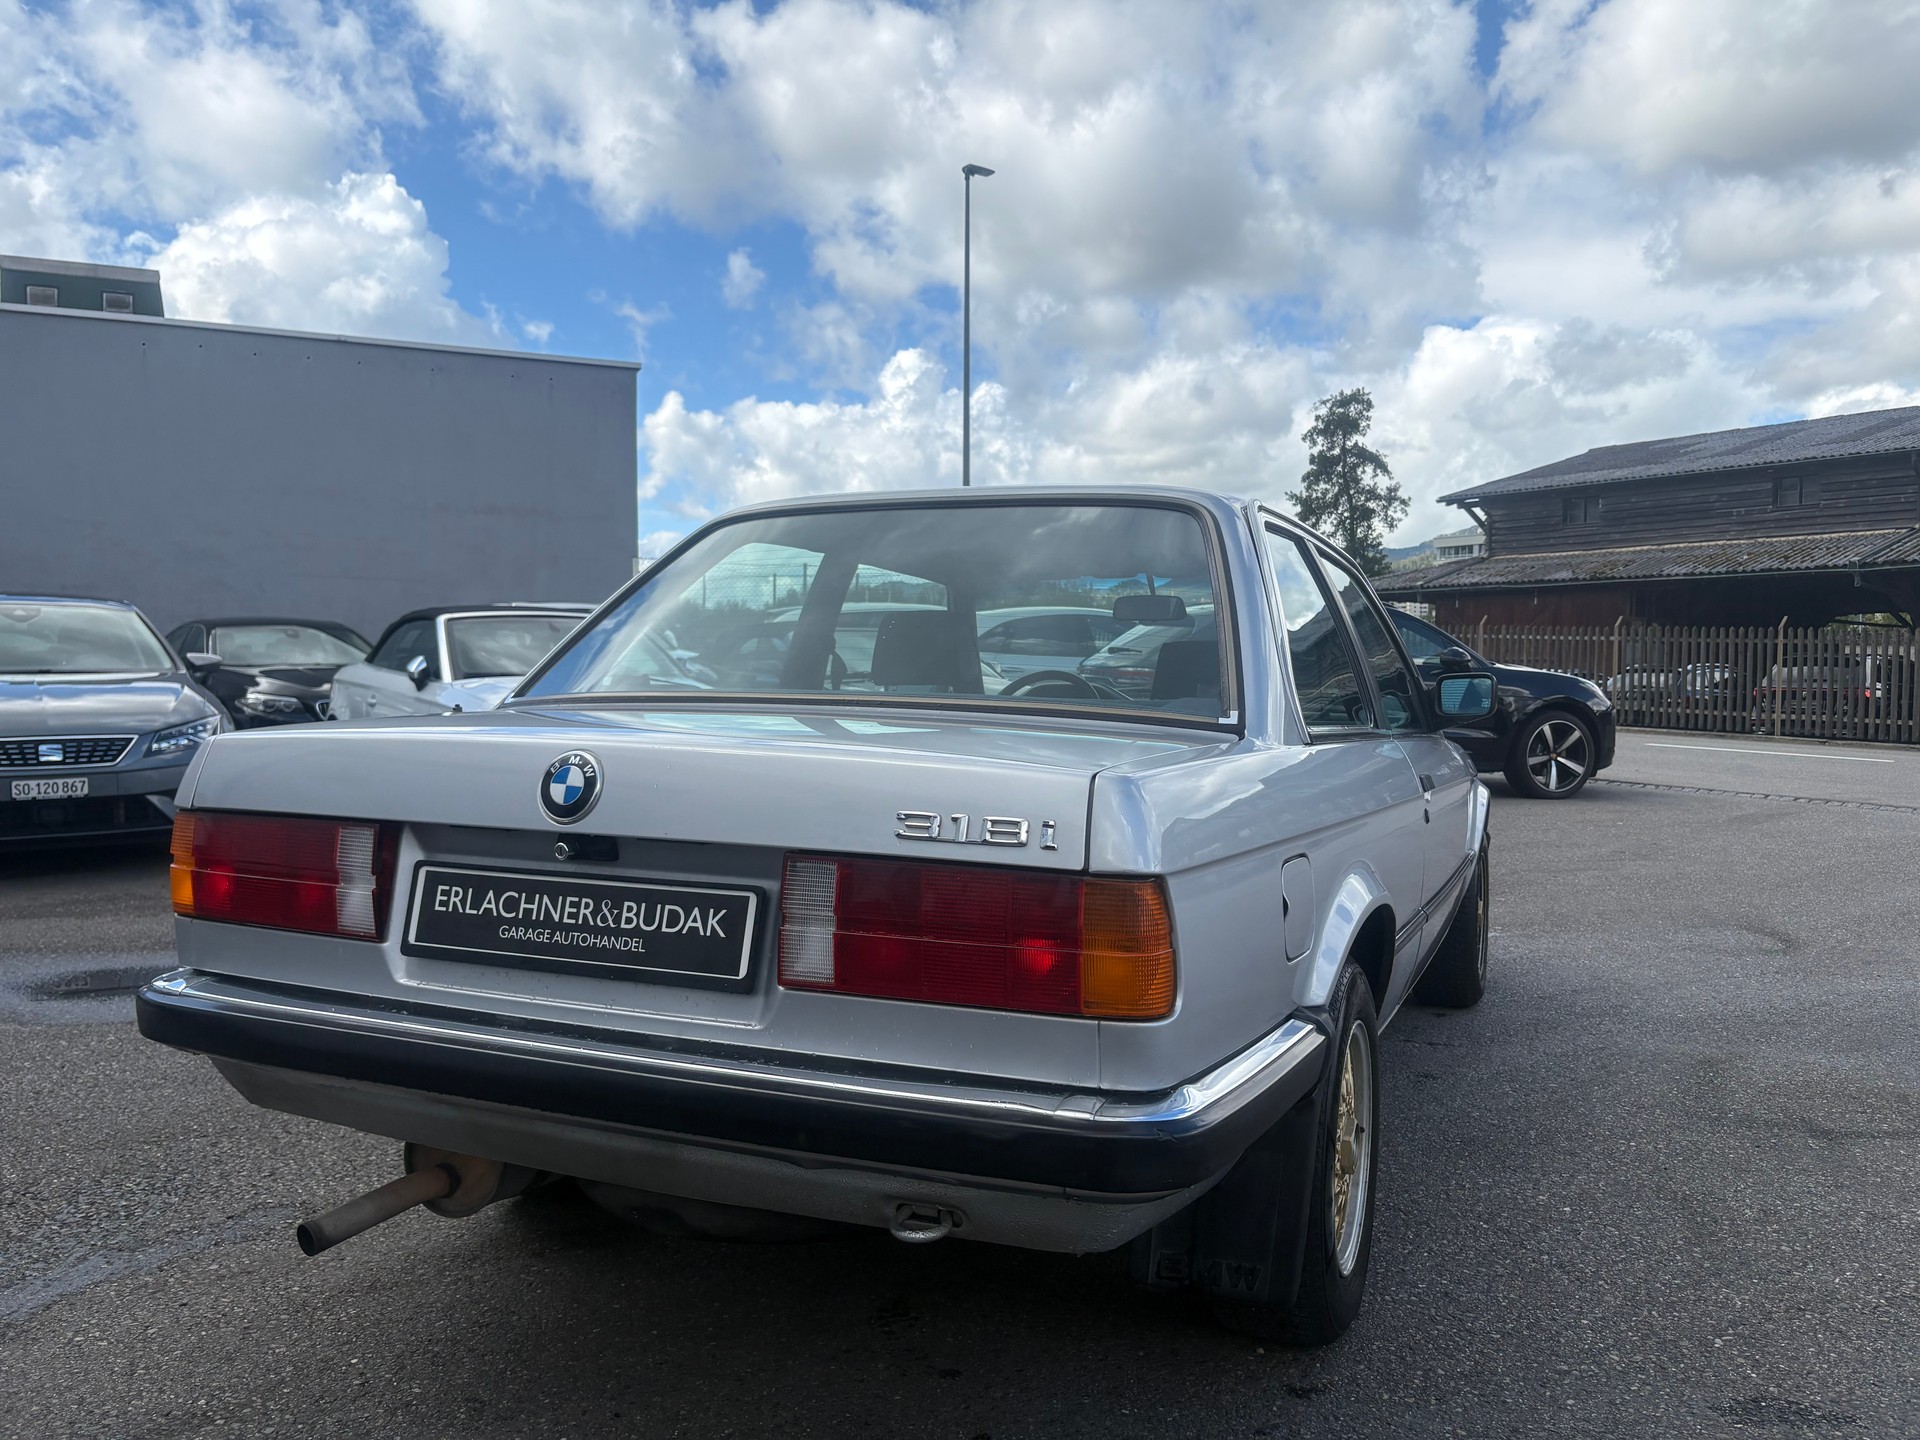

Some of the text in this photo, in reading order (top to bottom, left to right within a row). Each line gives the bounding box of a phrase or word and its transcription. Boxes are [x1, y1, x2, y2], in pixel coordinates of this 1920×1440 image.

[434, 885, 727, 938] ERLACHNER&BUDAK
[499, 925, 645, 952] GARAGE AUTOHANDEL
